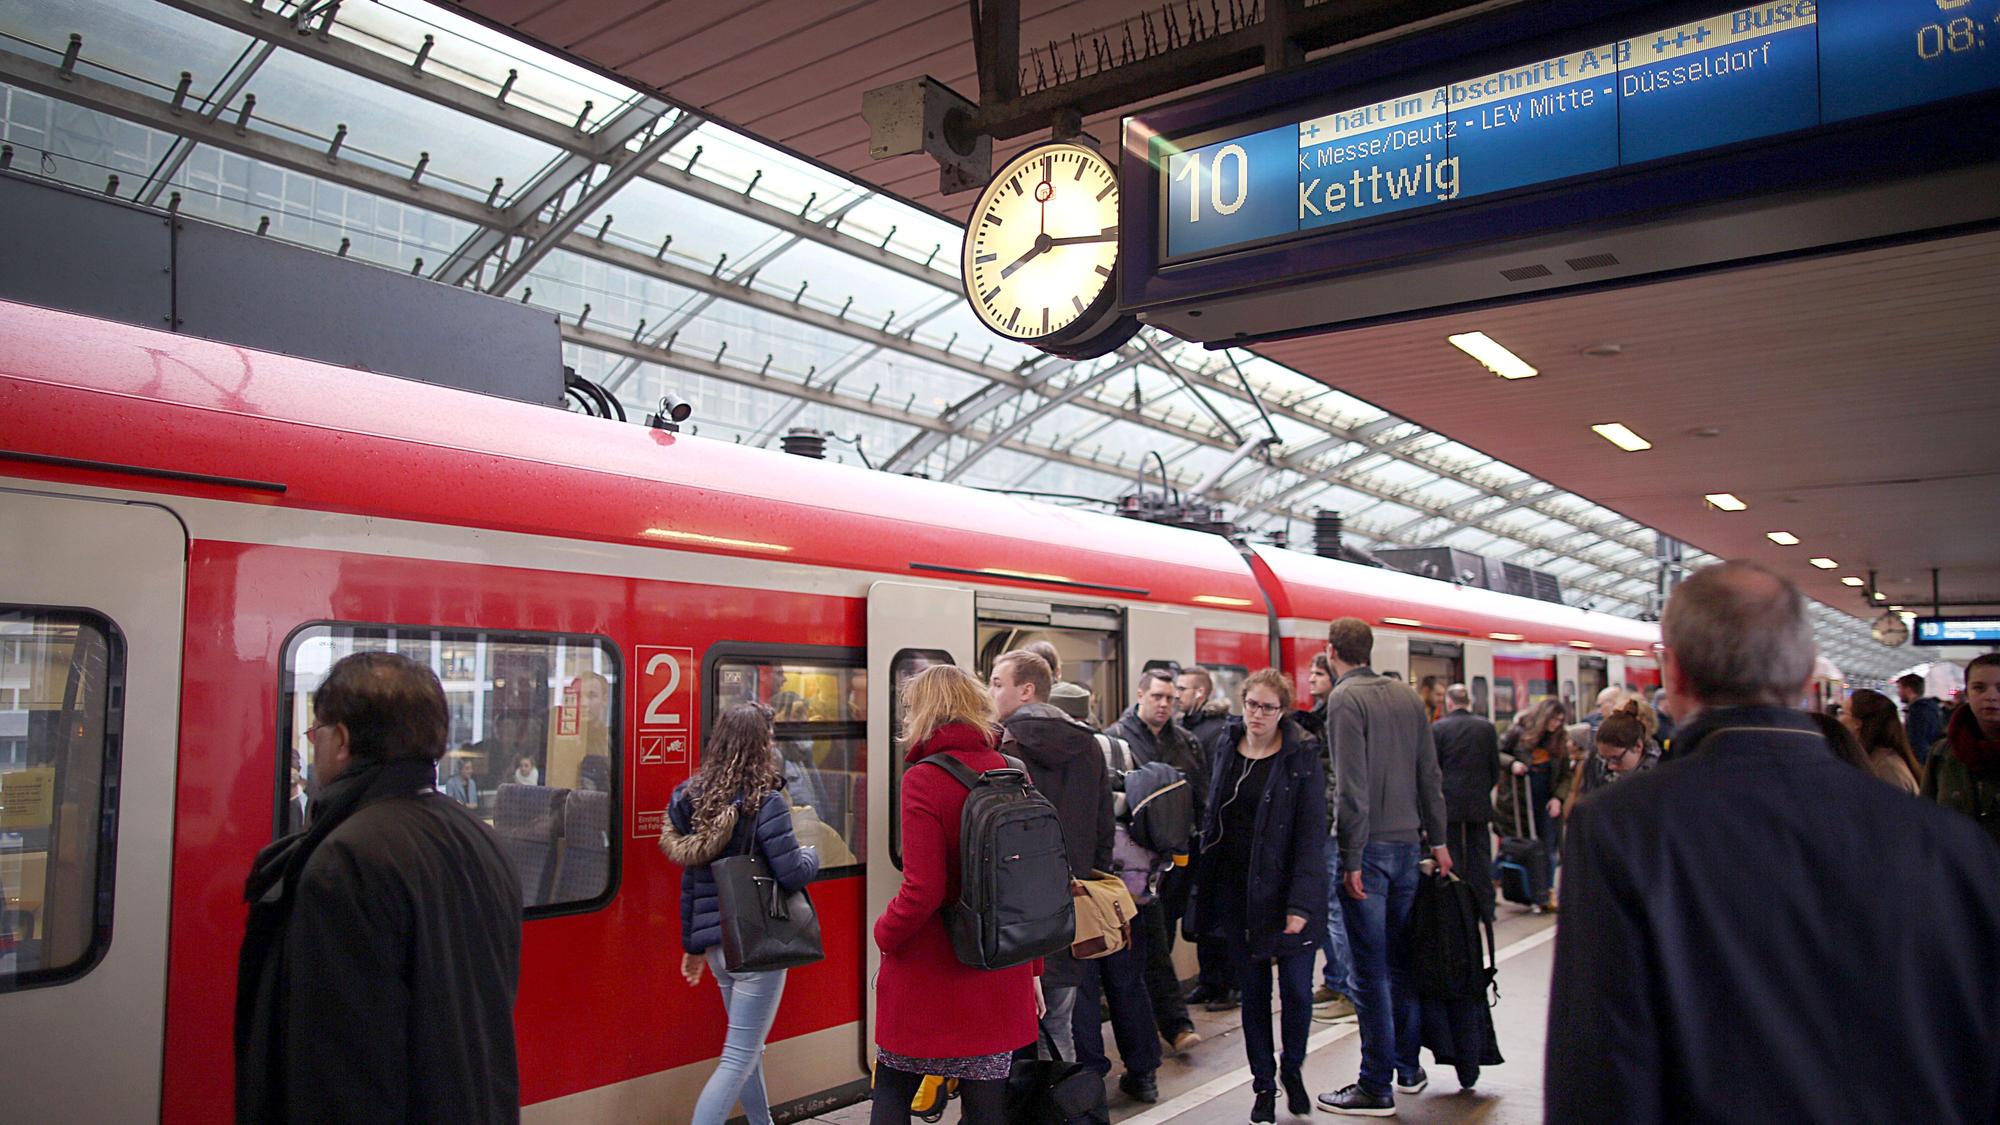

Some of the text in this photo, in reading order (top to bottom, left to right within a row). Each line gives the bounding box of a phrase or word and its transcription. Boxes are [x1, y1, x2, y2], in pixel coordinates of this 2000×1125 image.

[1299, 152, 1311, 172] K
[1317, 120, 1457, 168] Messe/Deutz
[1482, 102, 1522, 130] LEV
[1530, 88, 1594, 119] Mitte
[1623, 41, 1771, 97] Düsseldorf
[1335, 103, 1387, 133] hält
[1394, 97, 1423, 119] im
[1431, 57, 1569, 110] Abschnitt
[1578, 41, 1632, 73] A-B
[1175, 144, 1249, 223] 10
[1299, 153, 1460, 219] Kettwig
[644, 653, 681, 724] 2
